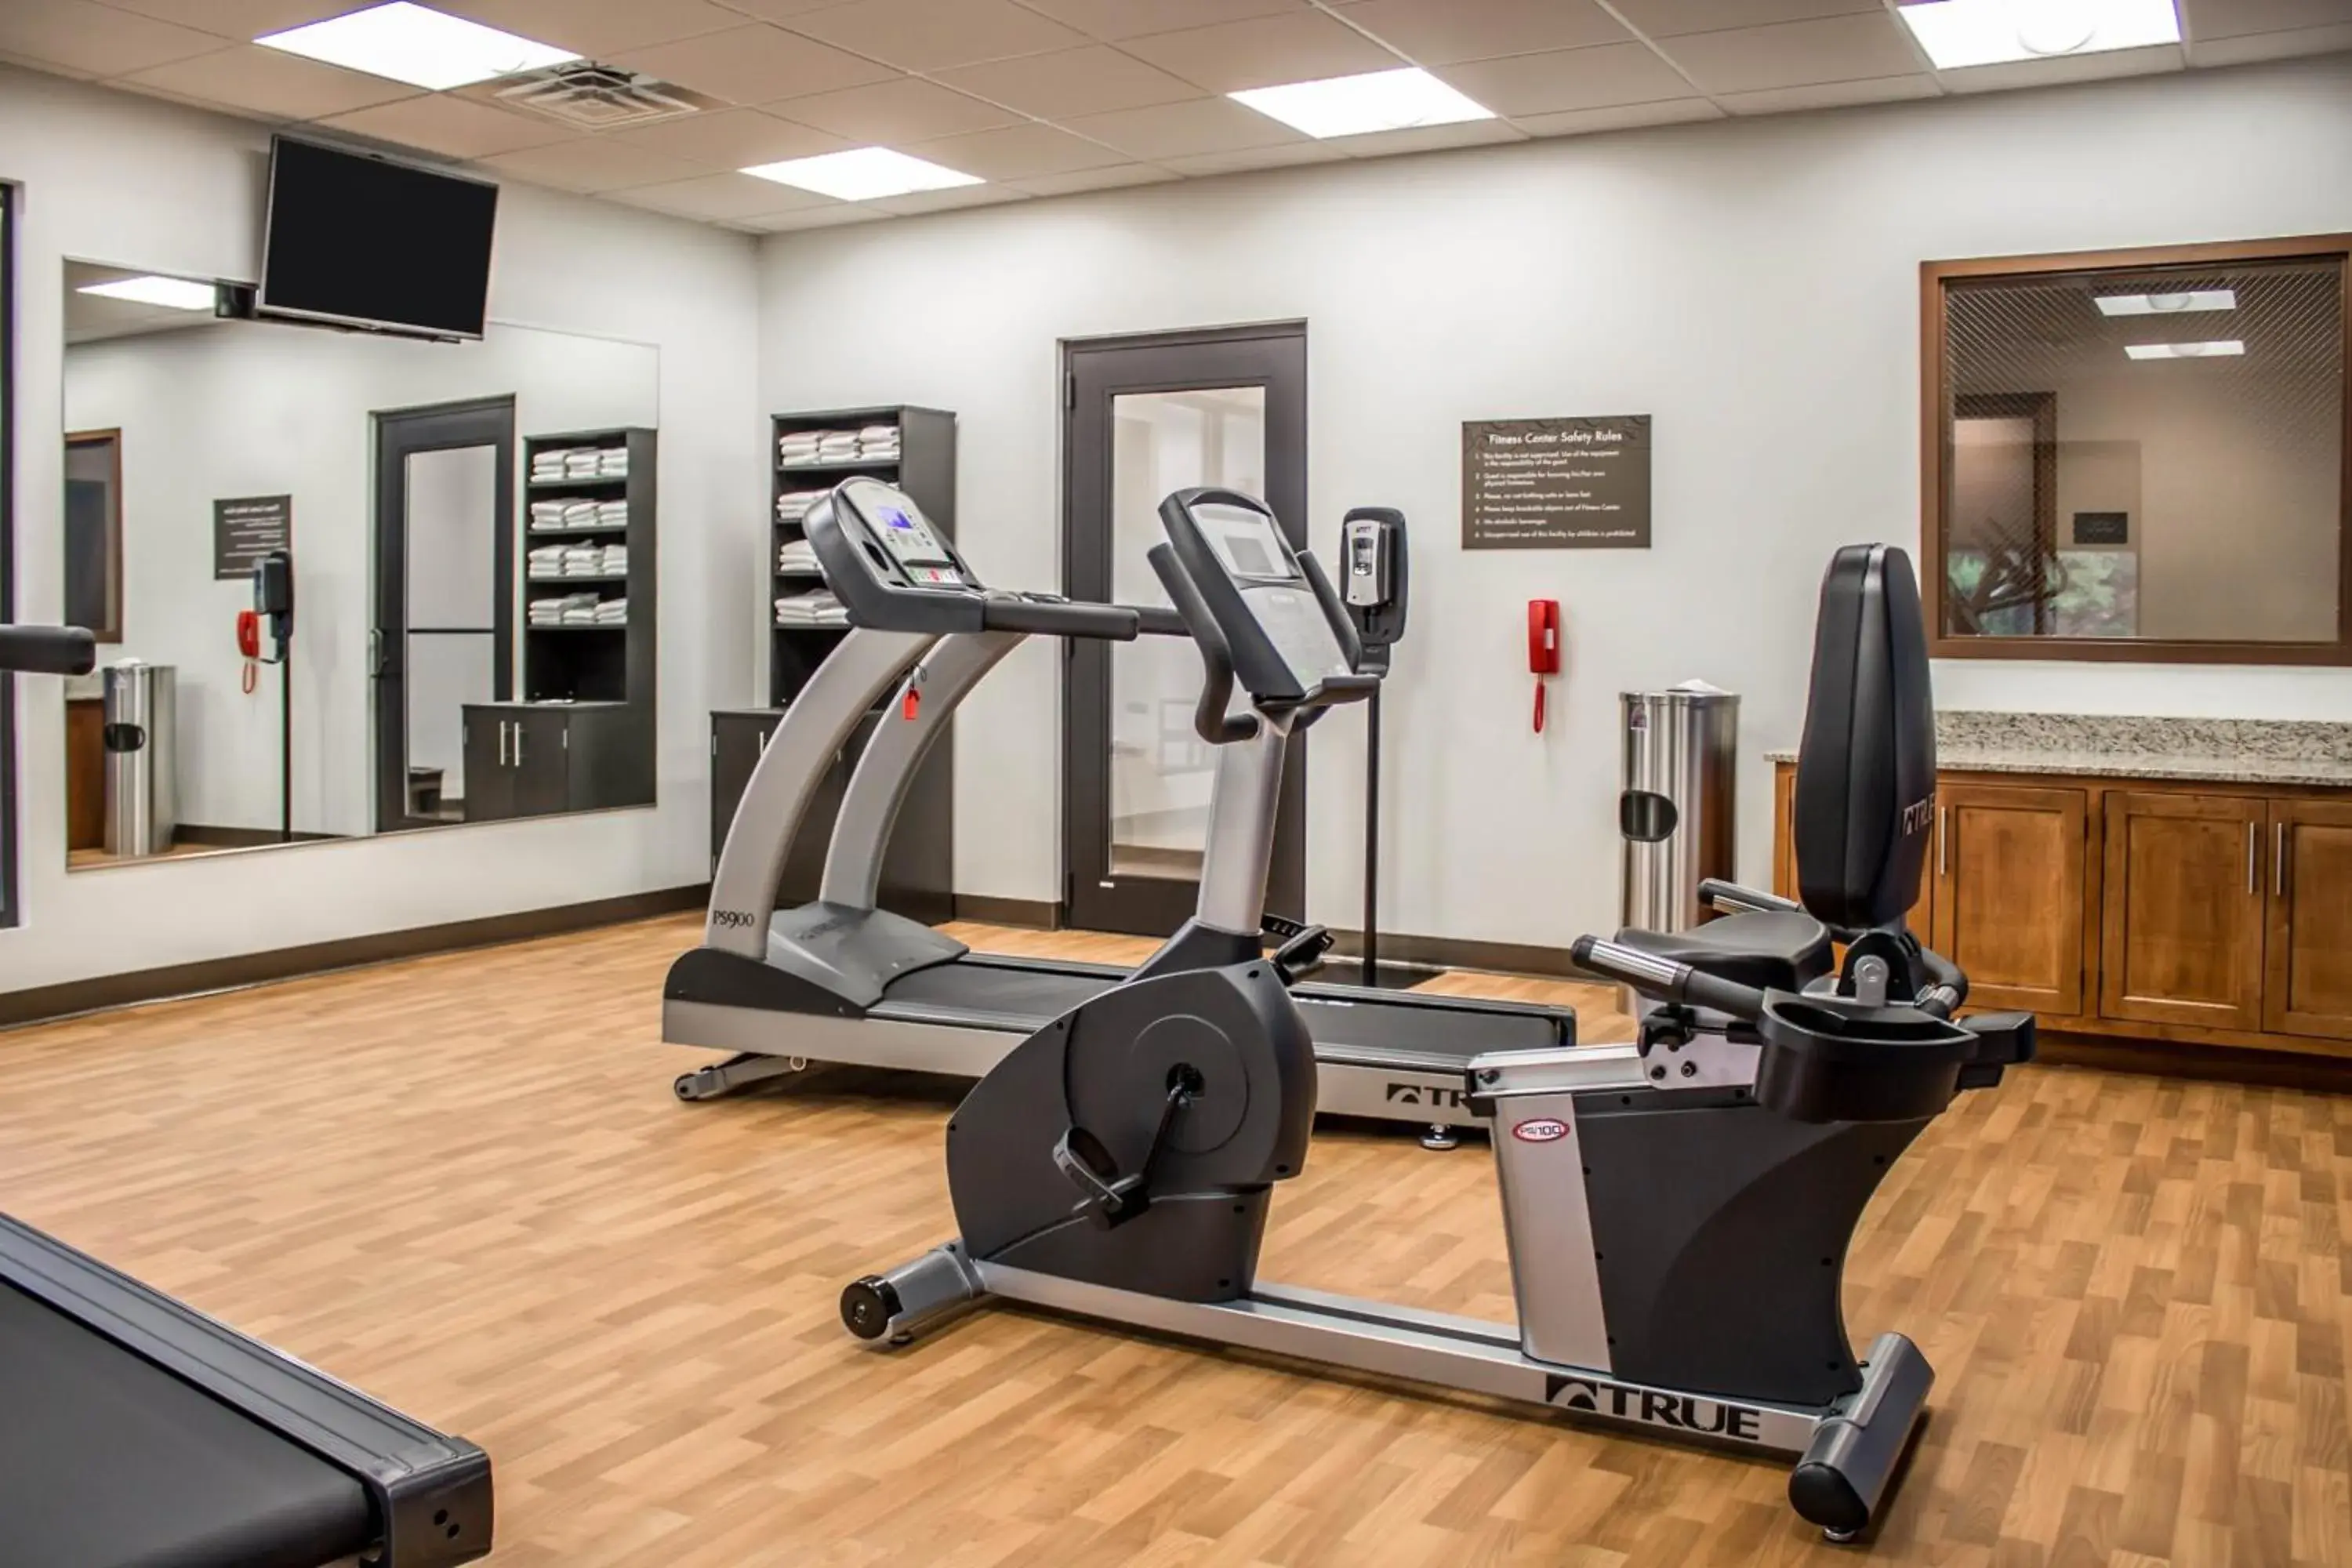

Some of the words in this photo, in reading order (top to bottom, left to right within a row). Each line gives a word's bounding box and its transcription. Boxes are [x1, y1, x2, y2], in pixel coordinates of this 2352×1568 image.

[1490, 433, 1523, 445] Fitness
[1525, 431, 1557, 443] Center
[1561, 430, 1592, 445] Safety
[1595, 429, 1622, 441] Rules
[713, 909, 754, 929] PS900
[1599, 1382, 1760, 1441] TRUE
